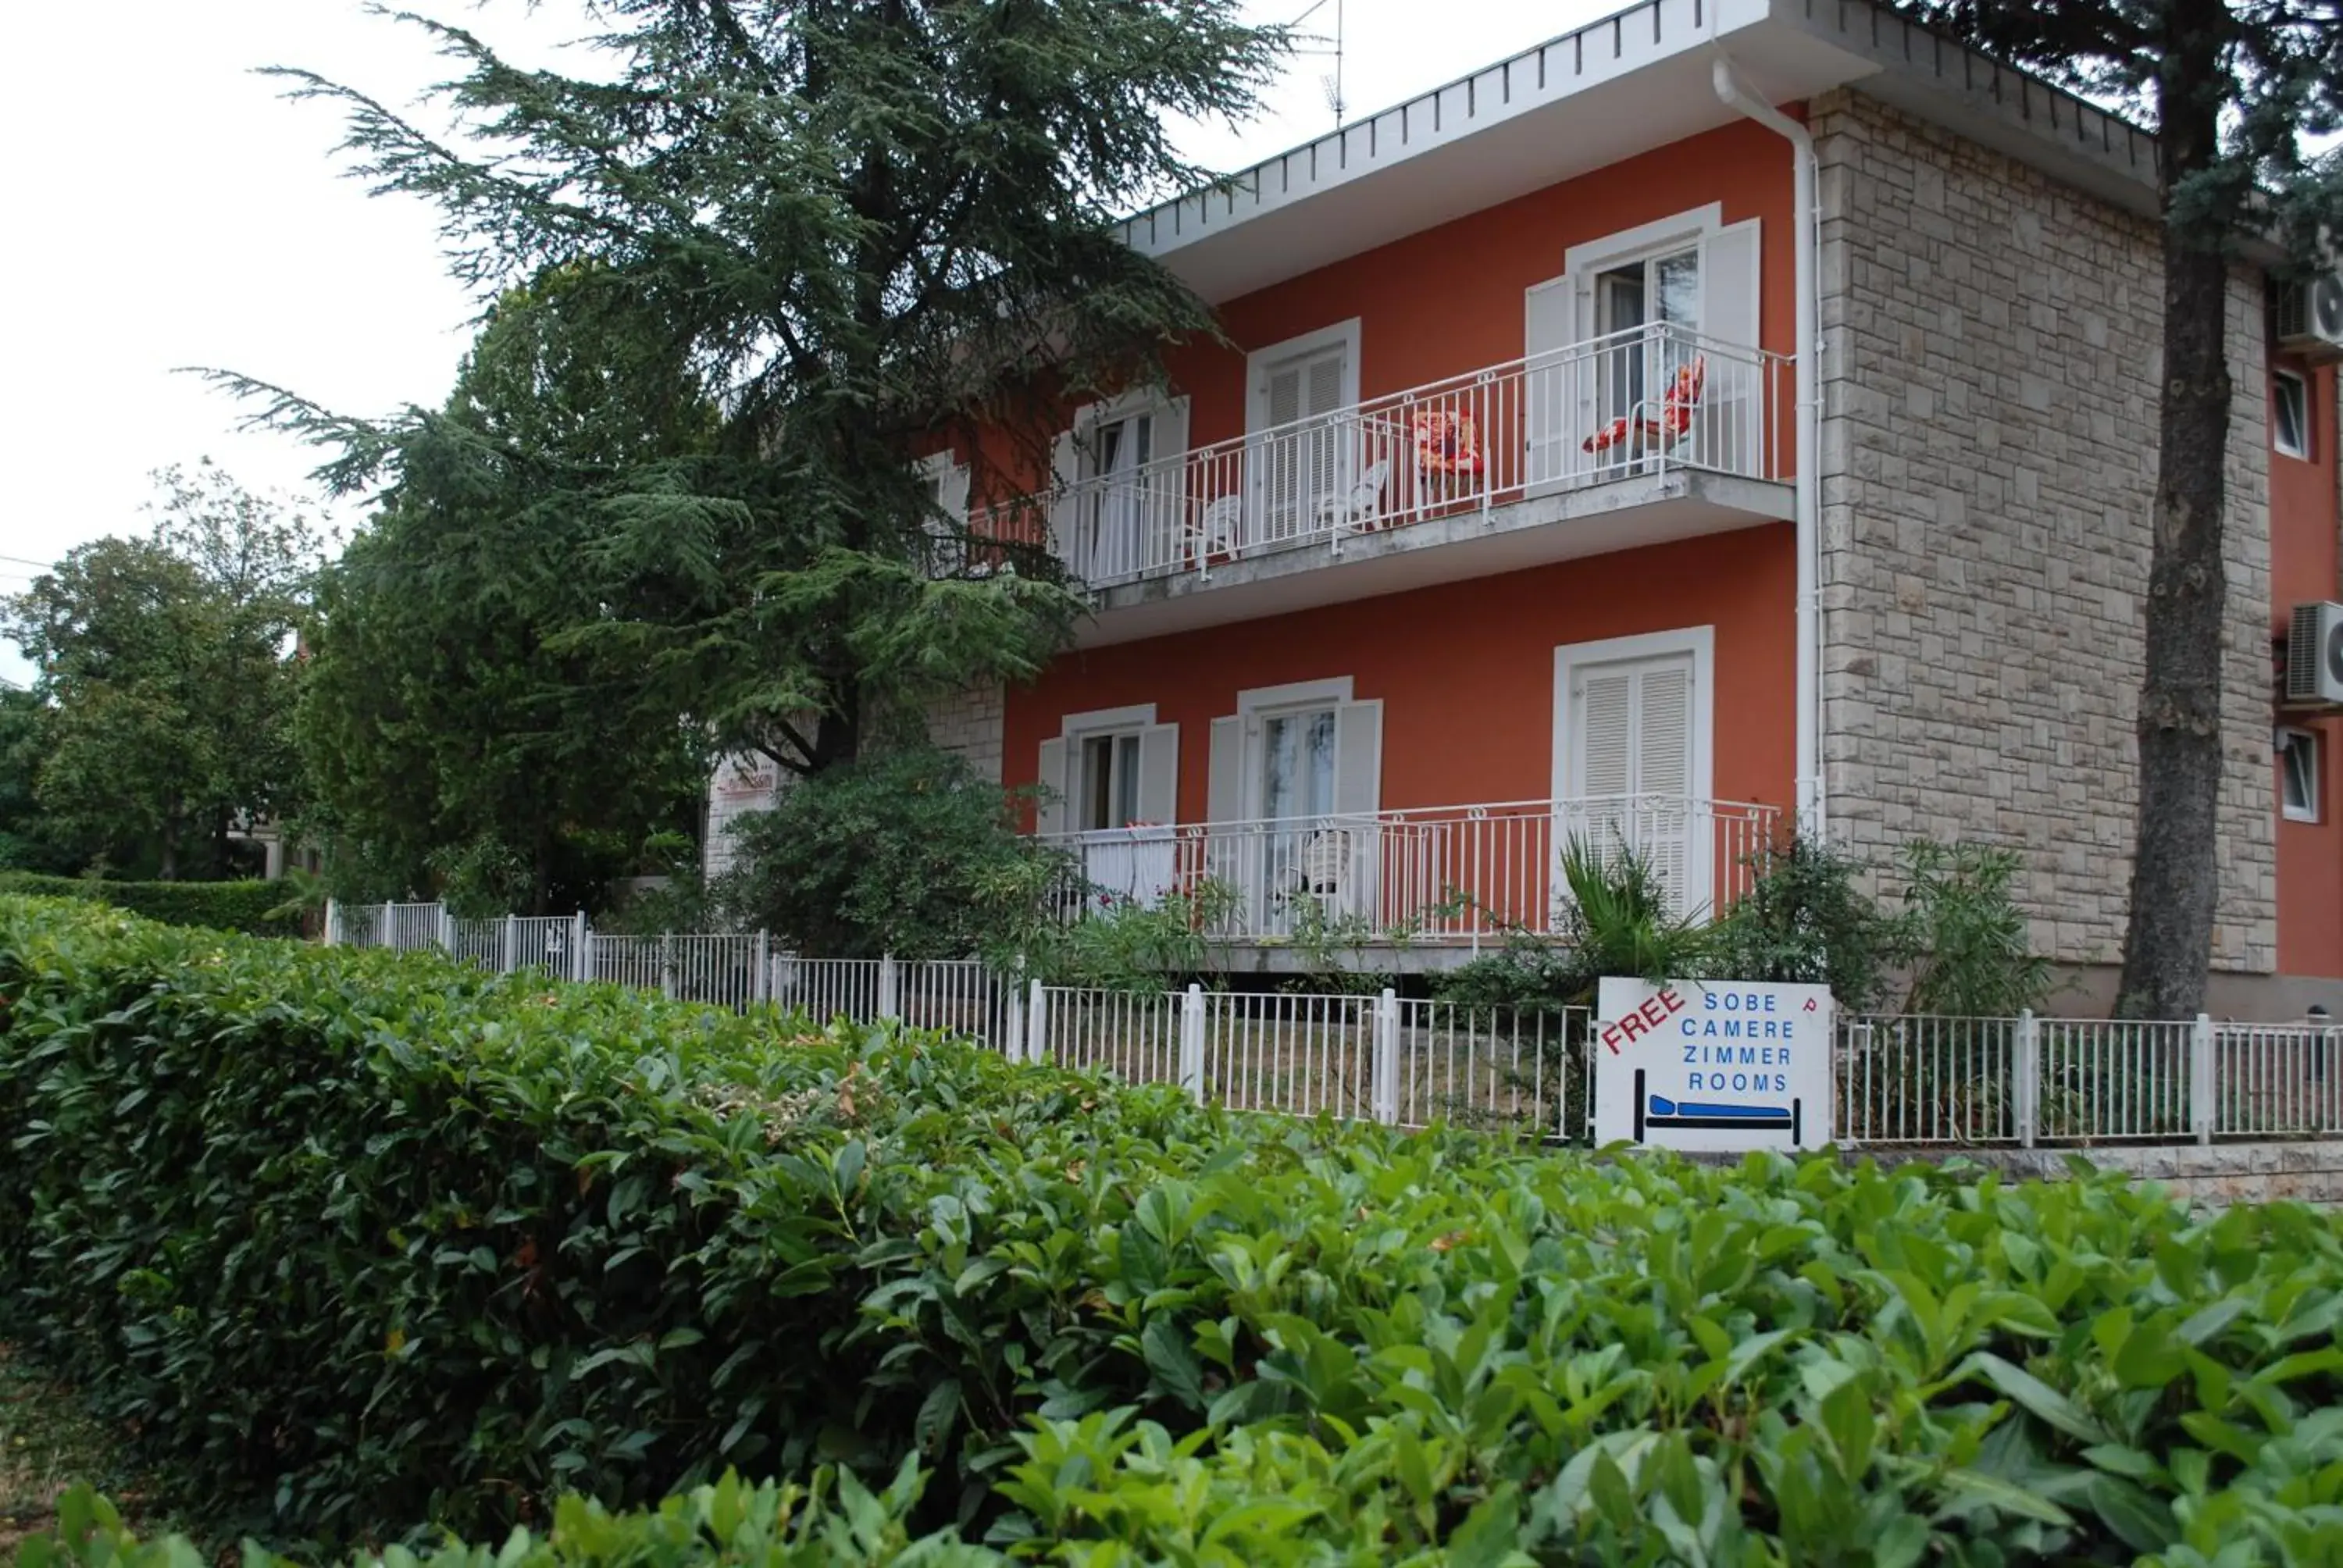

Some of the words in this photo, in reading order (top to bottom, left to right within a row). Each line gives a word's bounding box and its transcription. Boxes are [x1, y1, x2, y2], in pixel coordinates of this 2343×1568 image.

[1704, 992, 1775, 1012] SOBE
[1601, 987, 1685, 1055] FREE
[1681, 1018, 1793, 1039] CAMERE
[1684, 1046, 1790, 1064] ZIMMER
[1689, 1072, 1786, 1091] ROOMS
